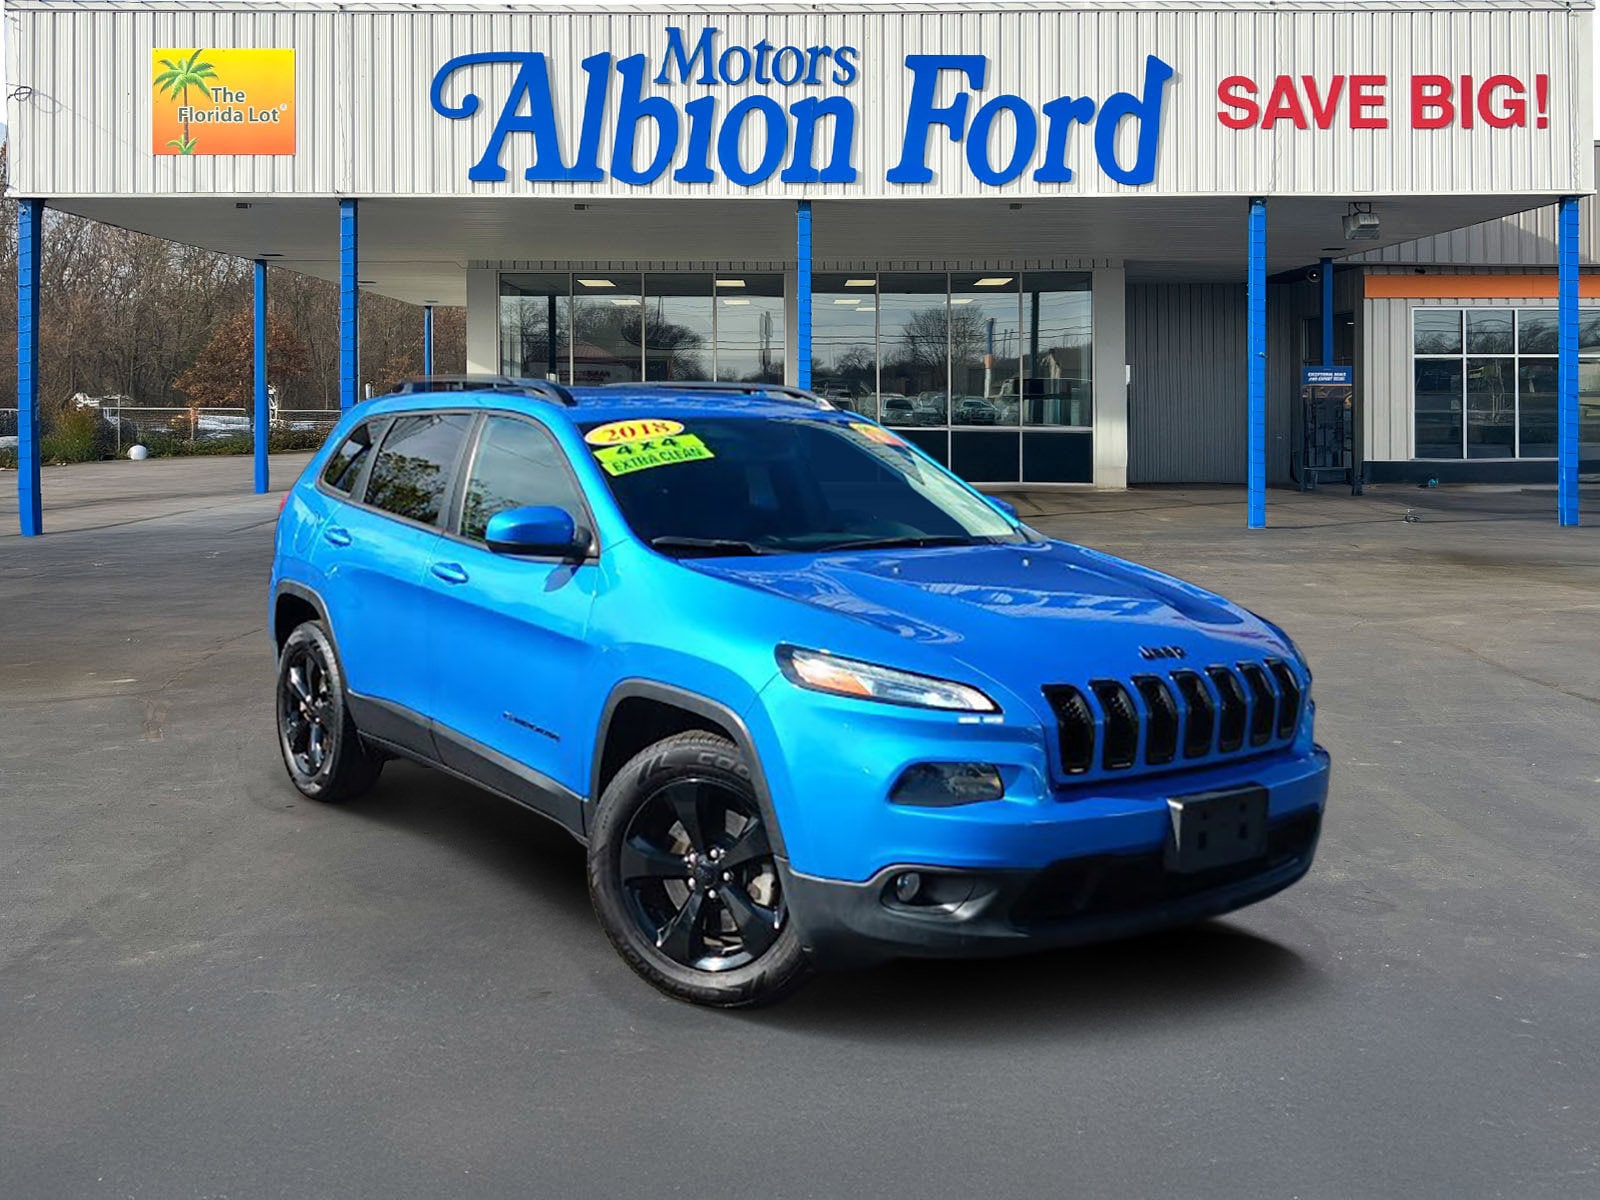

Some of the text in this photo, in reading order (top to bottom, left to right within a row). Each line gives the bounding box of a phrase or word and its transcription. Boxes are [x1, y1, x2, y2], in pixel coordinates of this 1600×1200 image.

[653, 27, 857, 85] Motors
[211, 87, 246, 103] The
[1217, 74, 1548, 129] SAVE BIG!
[178, 107, 280, 123] Florida Lot
[430, 52, 1173, 186] Albion Ford
[604, 421, 671, 442] 2018
